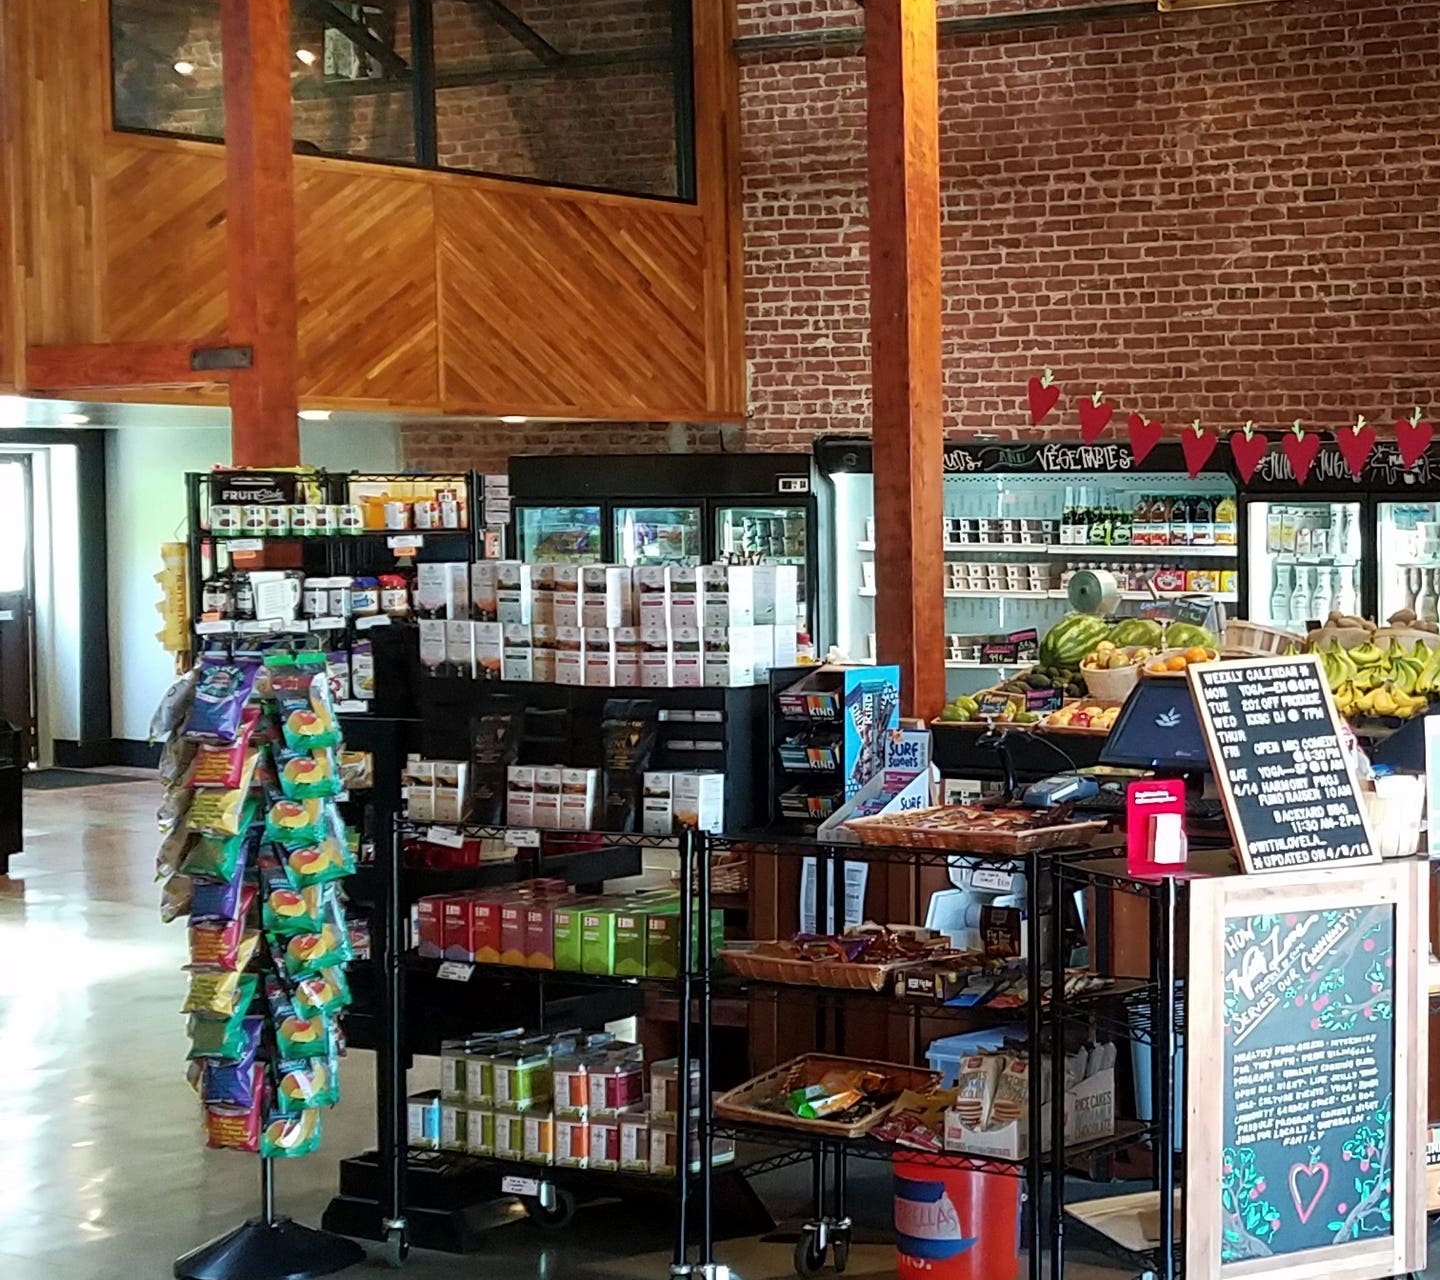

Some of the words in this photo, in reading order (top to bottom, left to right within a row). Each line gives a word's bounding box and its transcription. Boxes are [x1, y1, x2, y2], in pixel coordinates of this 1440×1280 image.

[944, 449, 982, 471] UITS
[1036, 443, 1135, 471] VEGETABLES
[222, 490, 258, 501] FRUIT
[1203, 670, 1244, 685] WEEKLY
[1246, 665, 1299, 682] CALENDAR
[1204, 686, 1228, 700] MON
[808, 706, 835, 717] KIND
[864, 693, 873, 725] KIND
[1208, 700, 1231, 714] TUE
[1261, 695, 1280, 709] OFF
[1281, 692, 1322, 708] PRODUCE
[1213, 715, 1238, 729] WED
[1273, 710, 1287, 724] DJ
[1217, 729, 1247, 744] THUR
[888, 741, 919, 757] SURF
[1223, 745, 1241, 758] FRI
[1254, 741, 1280, 756] OPEN
[1282, 739, 1300, 752] MIC
[1301, 735, 1337, 750] COMEDY
[810, 759, 836, 770] KIND
[1229, 768, 1247, 782] SAT
[1233, 782, 1259, 797] 4/14
[1261, 776, 1309, 793] HARMONY
[1312, 773, 1339, 788] PROJ
[900, 795, 922, 811] SURF
[1273, 805, 1326, 824] BACKYARD
[1326, 802, 1349, 817] BBQ
[1291, 819, 1319, 833] 11:30
[1224, 917, 1256, 958] HOW
[1277, 968, 1301, 993] OUR
[1234, 1087, 1256, 1100] OPEN
[1309, 1075, 1328, 1086] LIFE
[1330, 1082, 1353, 1094] YOGA
[1090, 1090, 1112, 1109] CAKES
